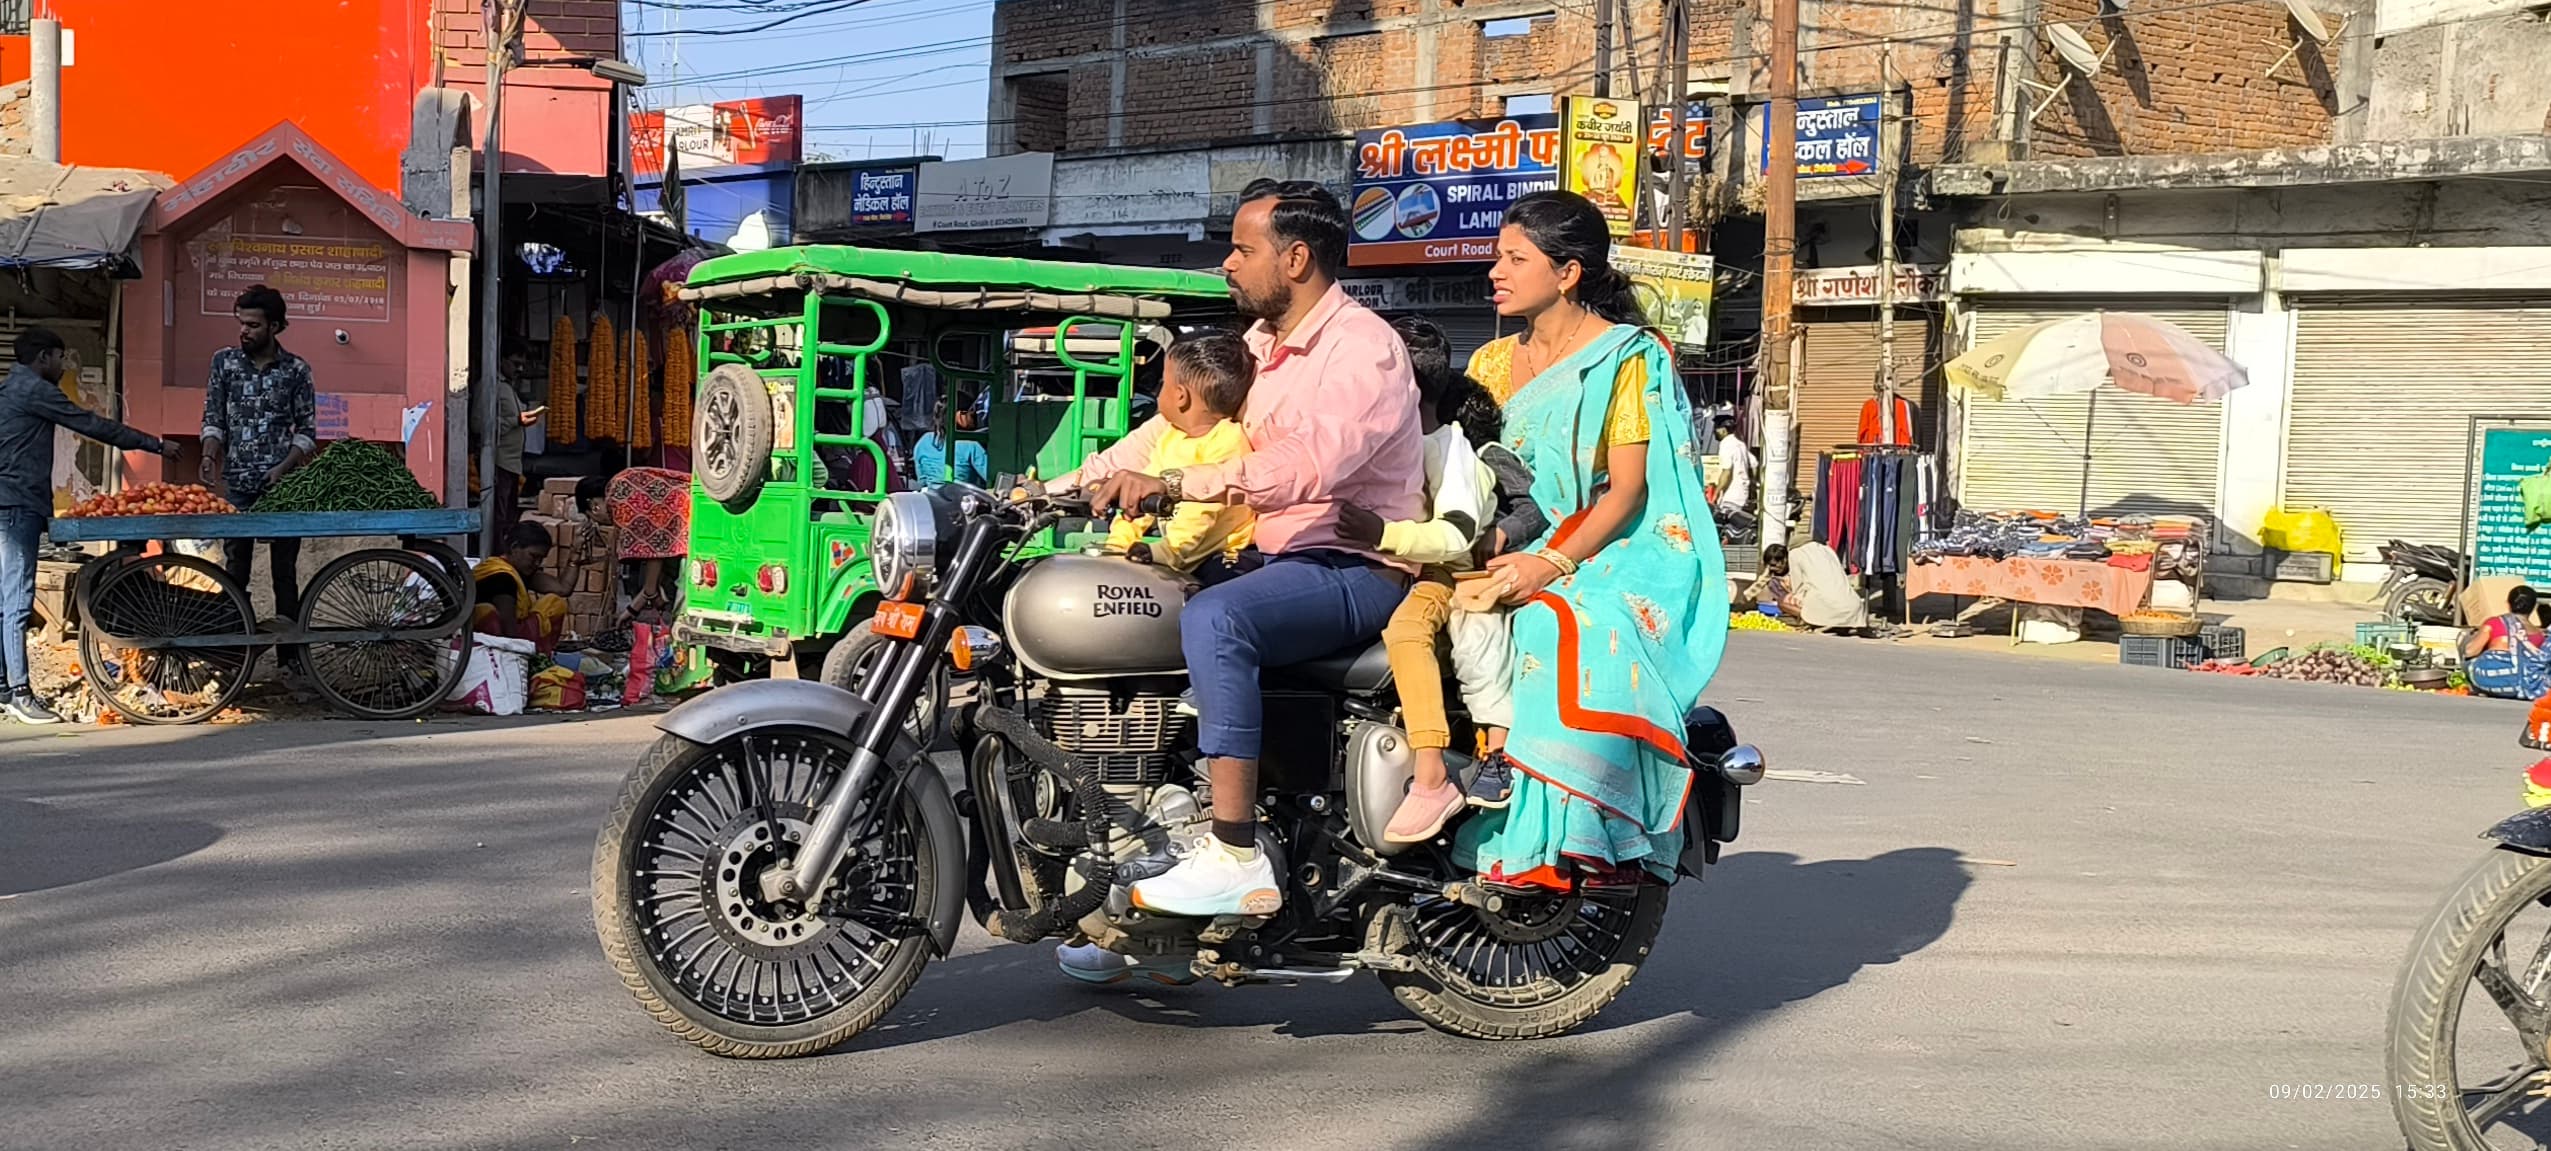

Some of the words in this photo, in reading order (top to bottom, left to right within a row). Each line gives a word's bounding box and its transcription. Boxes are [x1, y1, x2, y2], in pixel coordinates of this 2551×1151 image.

[1576, 117, 1602, 131] कबीर
[1604, 120, 1632, 134] जयंती
[1796, 107, 1860, 137] न्दुस्तान
[1357, 129, 1408, 179] श्री
[1410, 120, 1526, 175] लक्ष्मी
[1835, 132, 1871, 160] हॉल
[861, 172, 904, 194] हिन्दुस्तान
[1447, 183, 1503, 203] SPIRAL
[1506, 180, 1559, 200] BINDIN
[853, 193, 889, 212] मेडिकल
[891, 192, 910, 211] हॉल
[1460, 211, 1503, 230] LAMIN
[289, 244, 324, 257] प्रसाद
[1425, 244, 1459, 258] Court
[1461, 242, 1492, 256] Road
[1822, 270, 1880, 297] गणेश
[1096, 584, 1154, 600] ROYAL
[1093, 602, 1162, 617] ENFIELD
